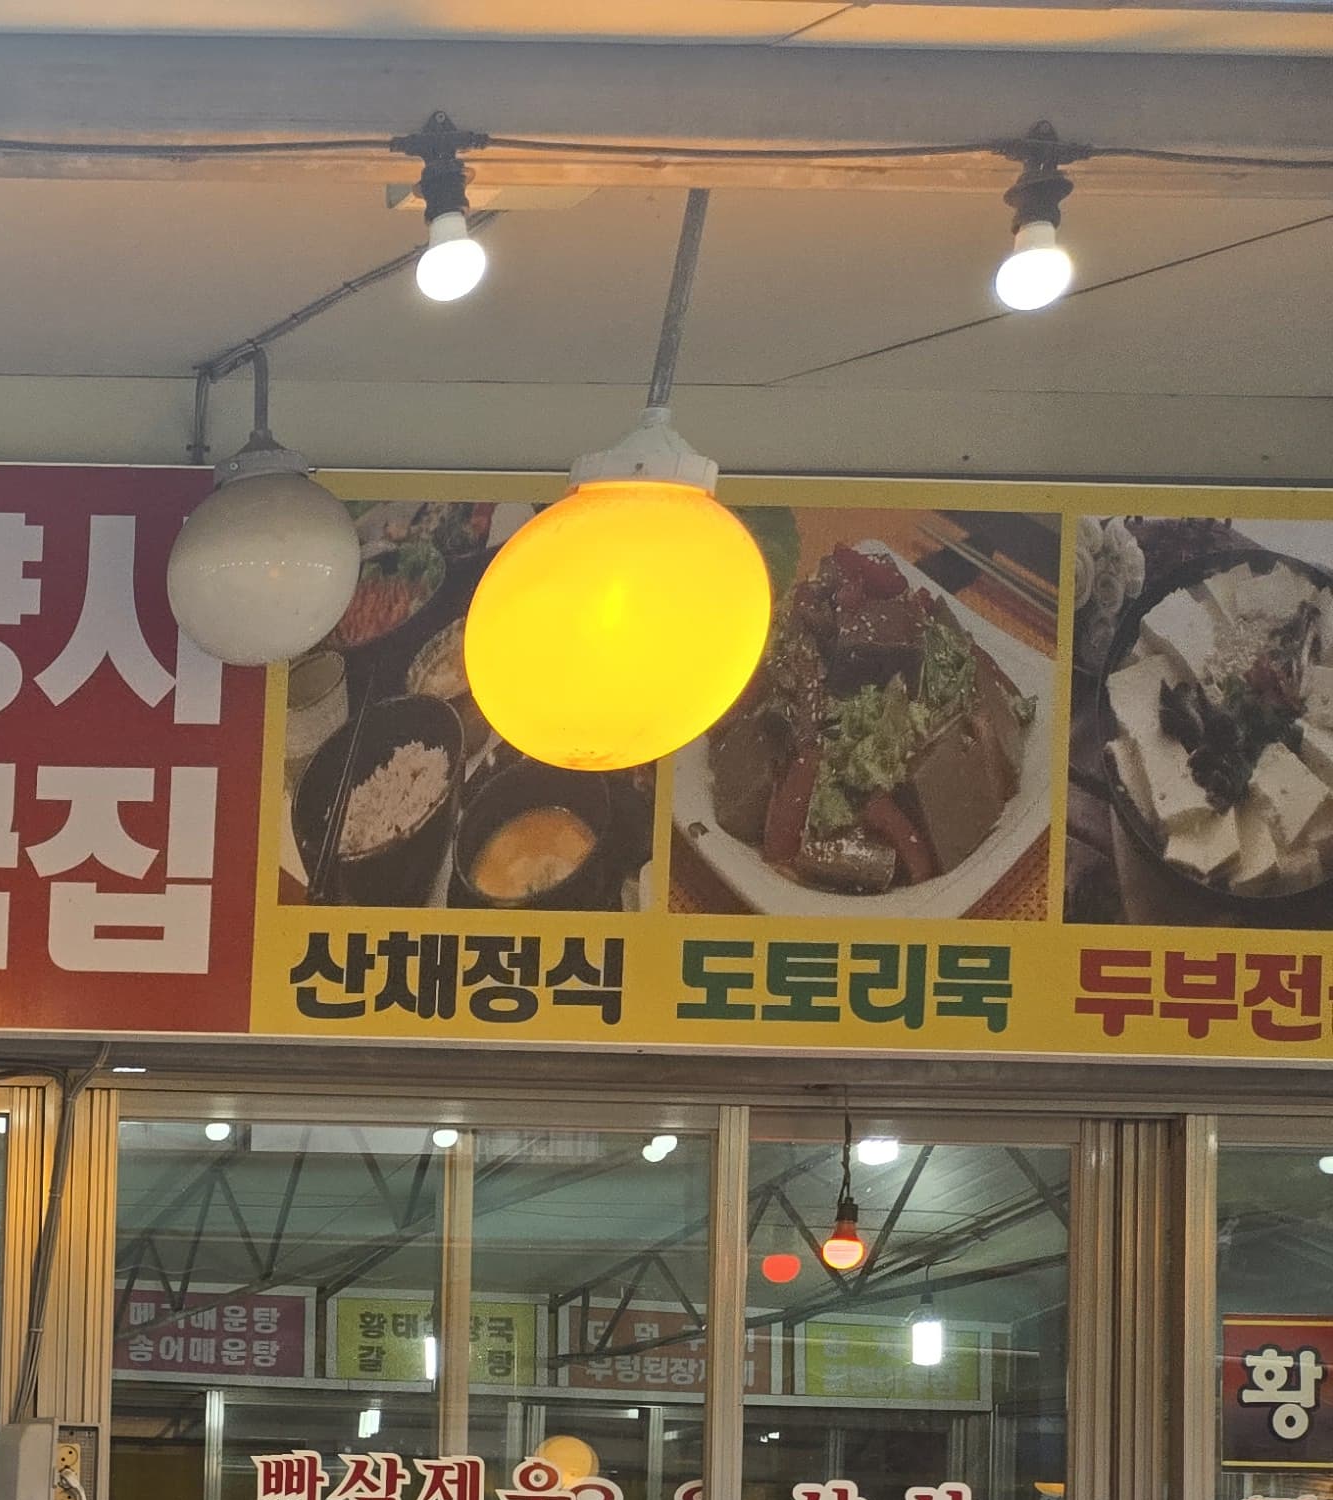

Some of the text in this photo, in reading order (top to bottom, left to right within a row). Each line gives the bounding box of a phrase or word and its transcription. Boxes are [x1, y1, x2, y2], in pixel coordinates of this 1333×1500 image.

[289, 931, 1333, 1042] 산채정식 도토리묵 두부전
[1241, 1348, 1323, 1440] 황
